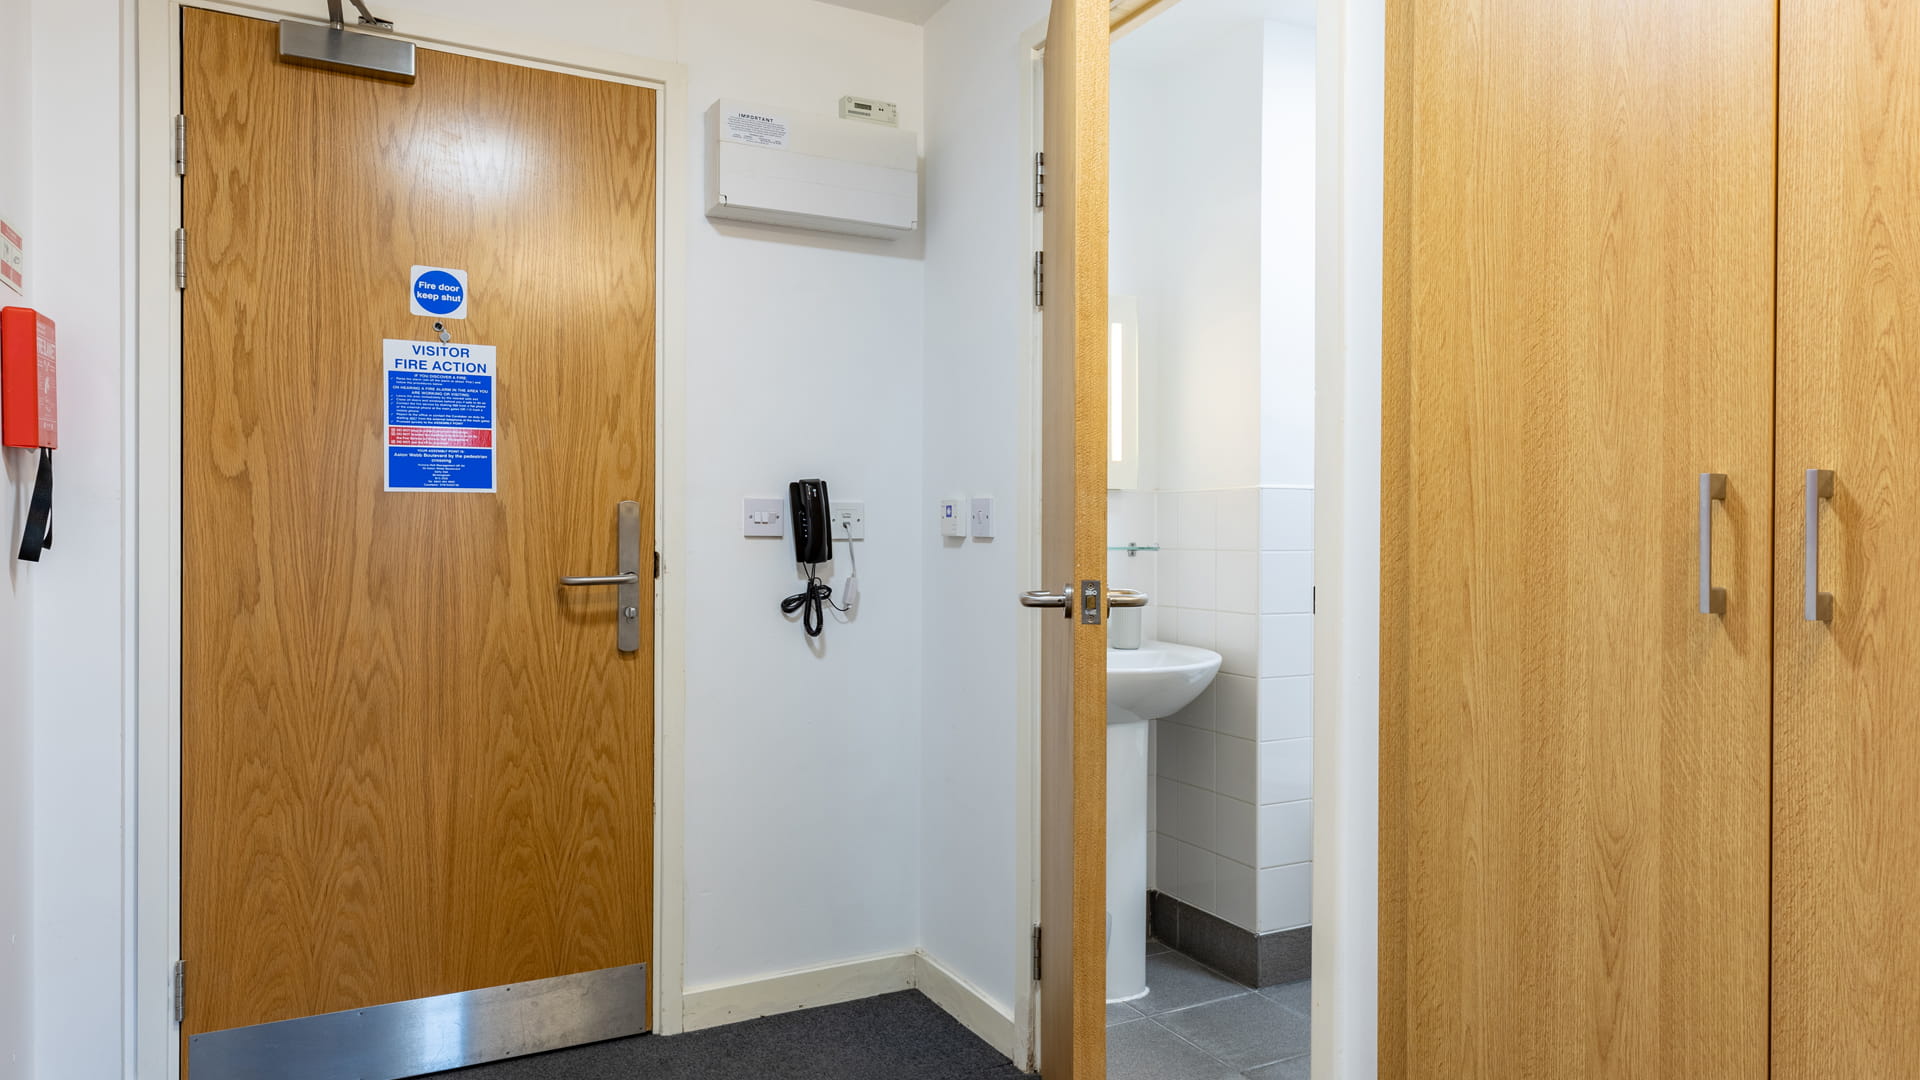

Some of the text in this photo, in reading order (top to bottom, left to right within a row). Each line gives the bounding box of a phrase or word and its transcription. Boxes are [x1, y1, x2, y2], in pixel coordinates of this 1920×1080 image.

[738, 113, 774, 122] IMPORTANT
[418, 281, 460, 292] Fire door
[417, 291, 460, 302] keep shut
[412, 345, 470, 358] VISITOR
[395, 359, 486, 373] FIRE ACTION
